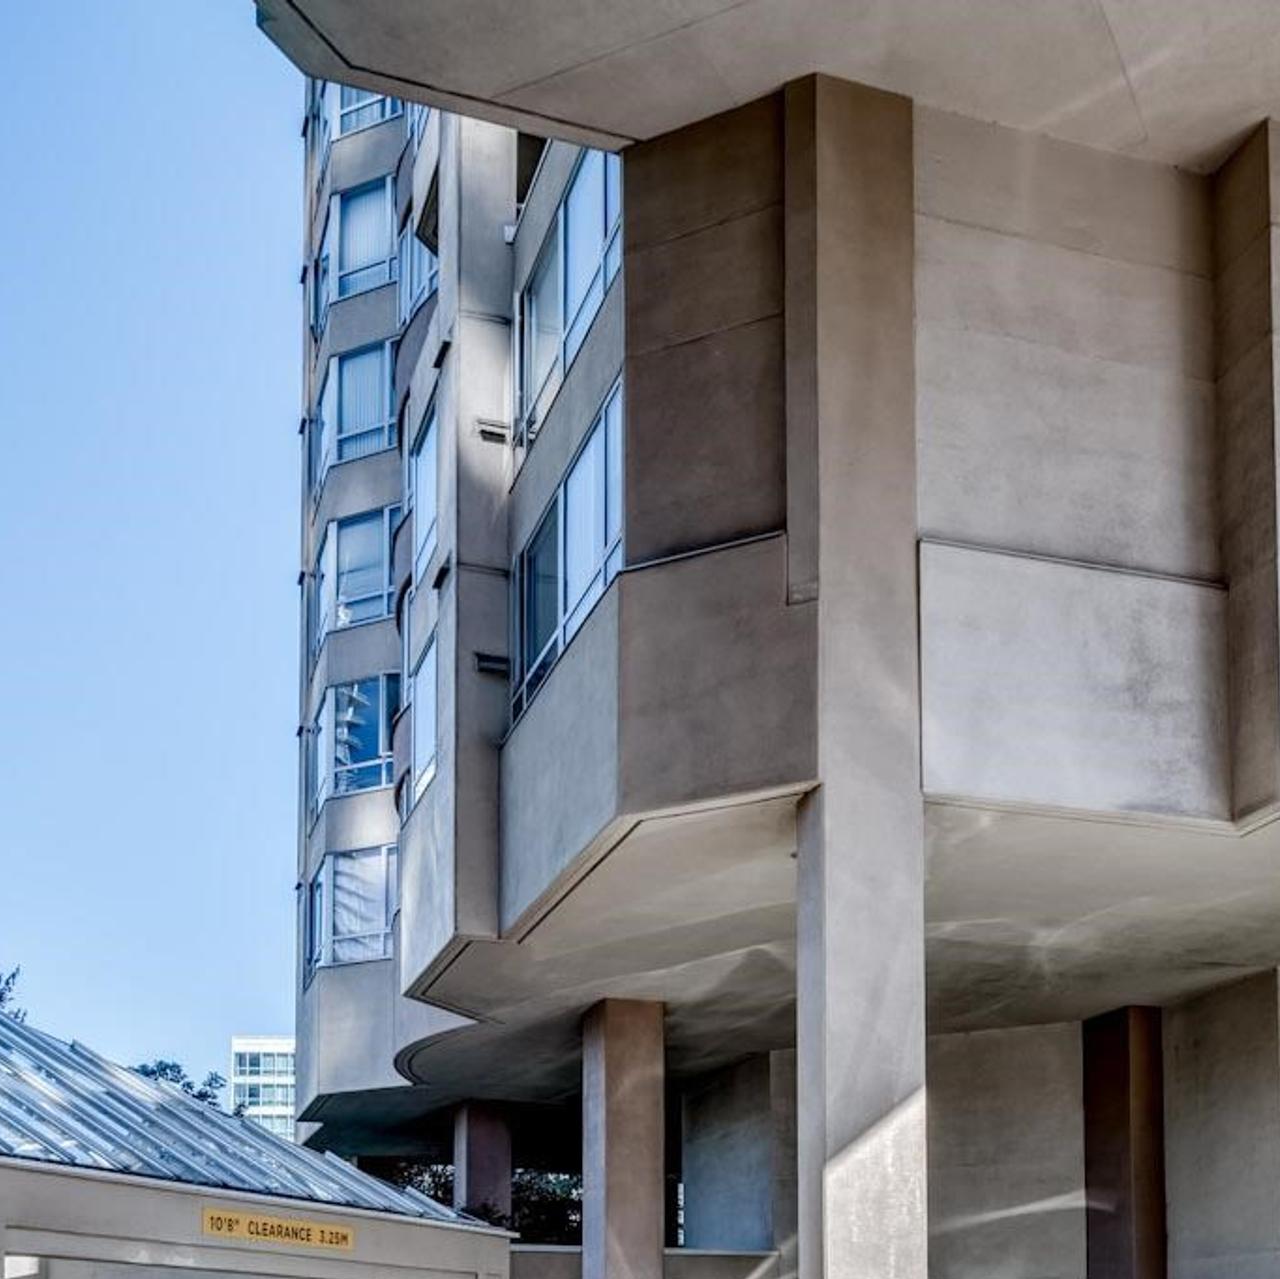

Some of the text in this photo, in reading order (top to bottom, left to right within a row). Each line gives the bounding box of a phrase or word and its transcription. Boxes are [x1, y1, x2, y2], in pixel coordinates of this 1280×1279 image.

[209, 1215, 349, 1246] 10'8" CLEARANCE 3.25M
